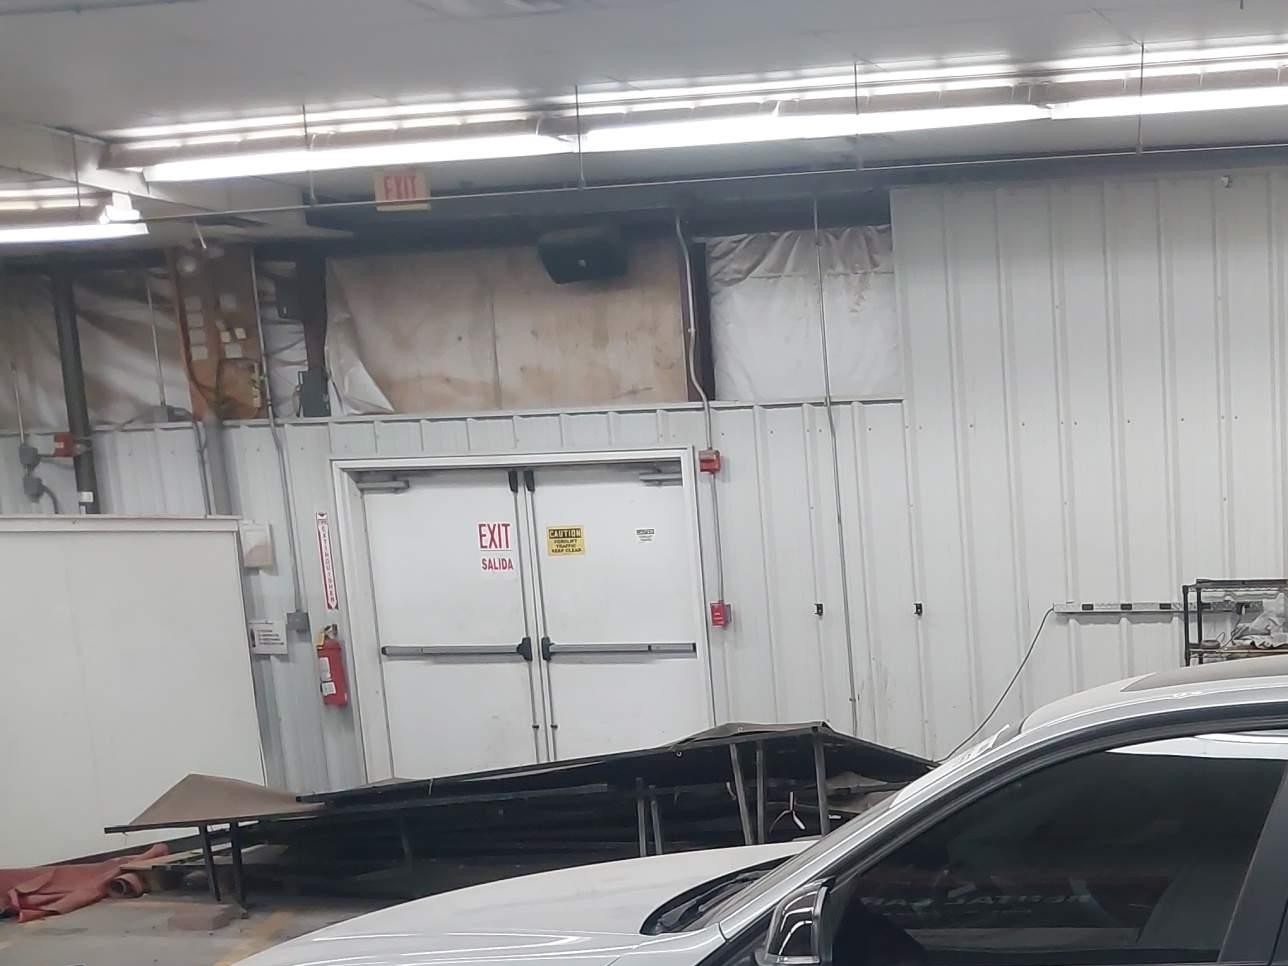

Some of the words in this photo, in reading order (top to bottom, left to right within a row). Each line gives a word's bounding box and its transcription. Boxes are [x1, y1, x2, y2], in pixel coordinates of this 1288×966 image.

[383, 175, 417, 201] EXIT
[478, 523, 511, 549] EXIT
[549, 529, 581, 538] CAUTION
[481, 558, 514, 570] SALIDA
